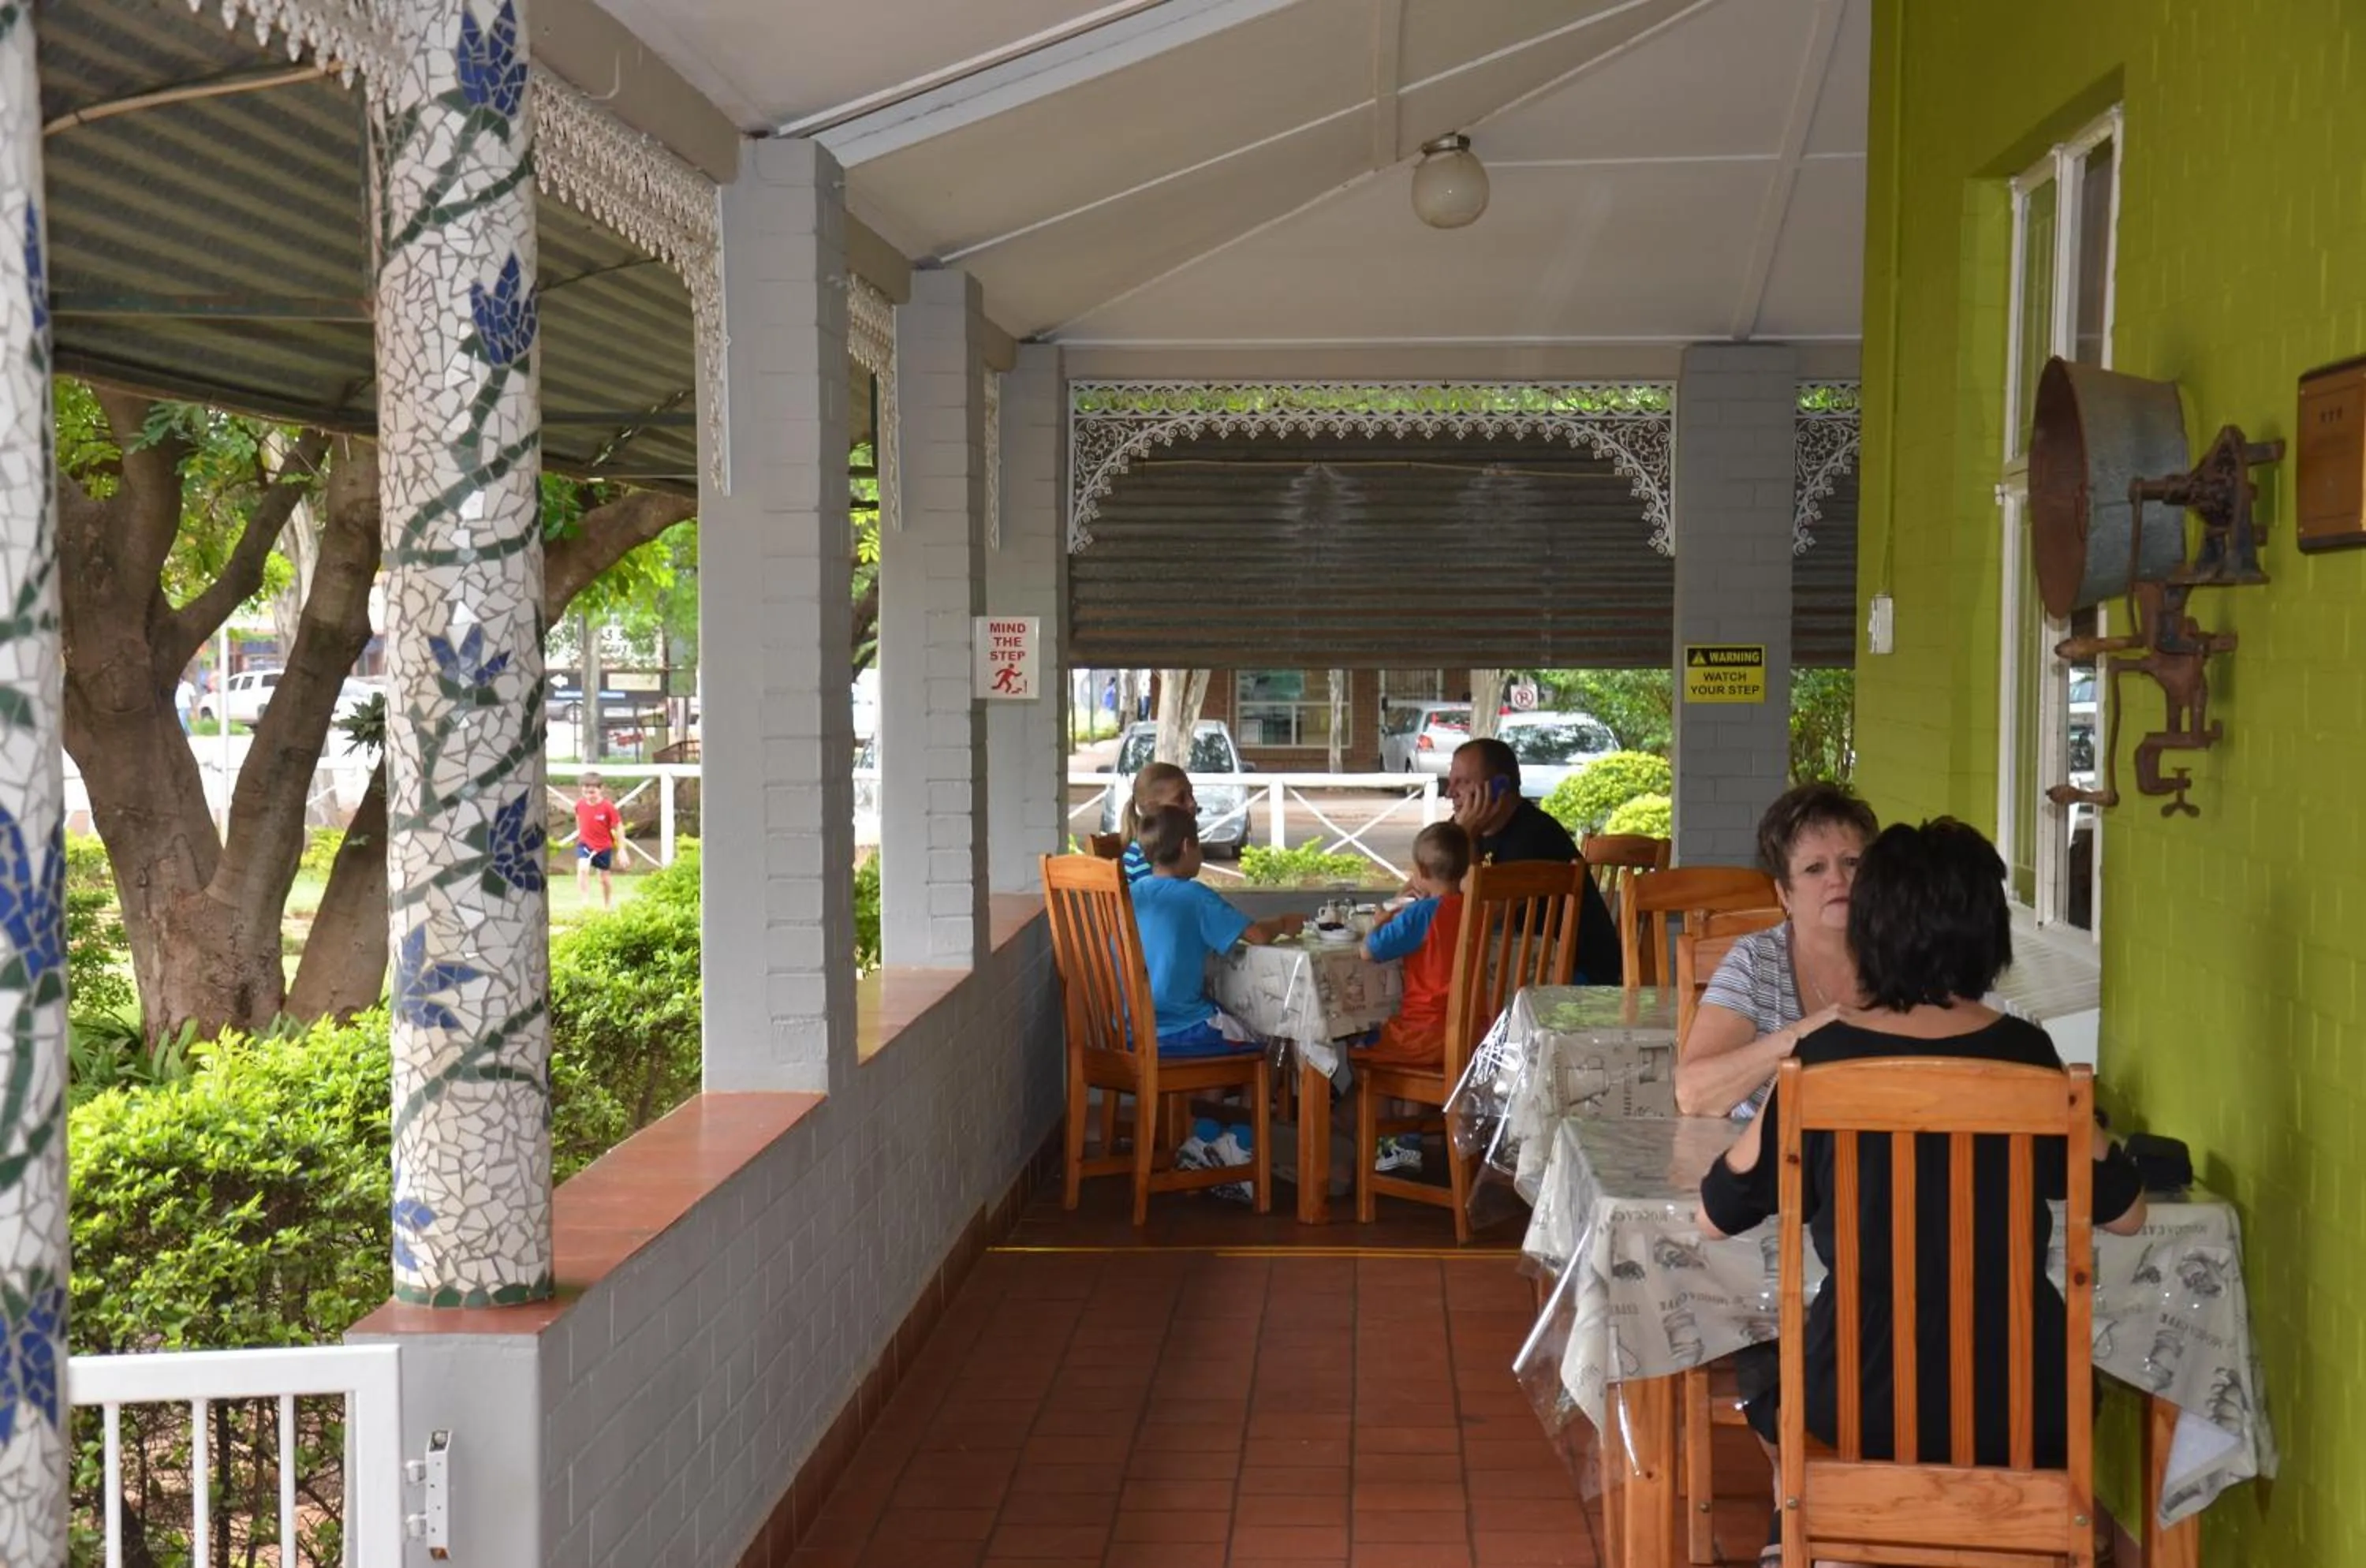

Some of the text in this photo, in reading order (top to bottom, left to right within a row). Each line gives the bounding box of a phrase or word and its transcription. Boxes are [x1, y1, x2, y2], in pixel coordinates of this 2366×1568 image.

[989, 622, 1026, 633] MIND
[993, 637, 1022, 647] THE
[989, 651, 1026, 662] STEP
[1709, 651, 1760, 663] WARNING
[1703, 671, 1747, 682] WATCH
[1690, 685, 1760, 695] YOUR STEP
